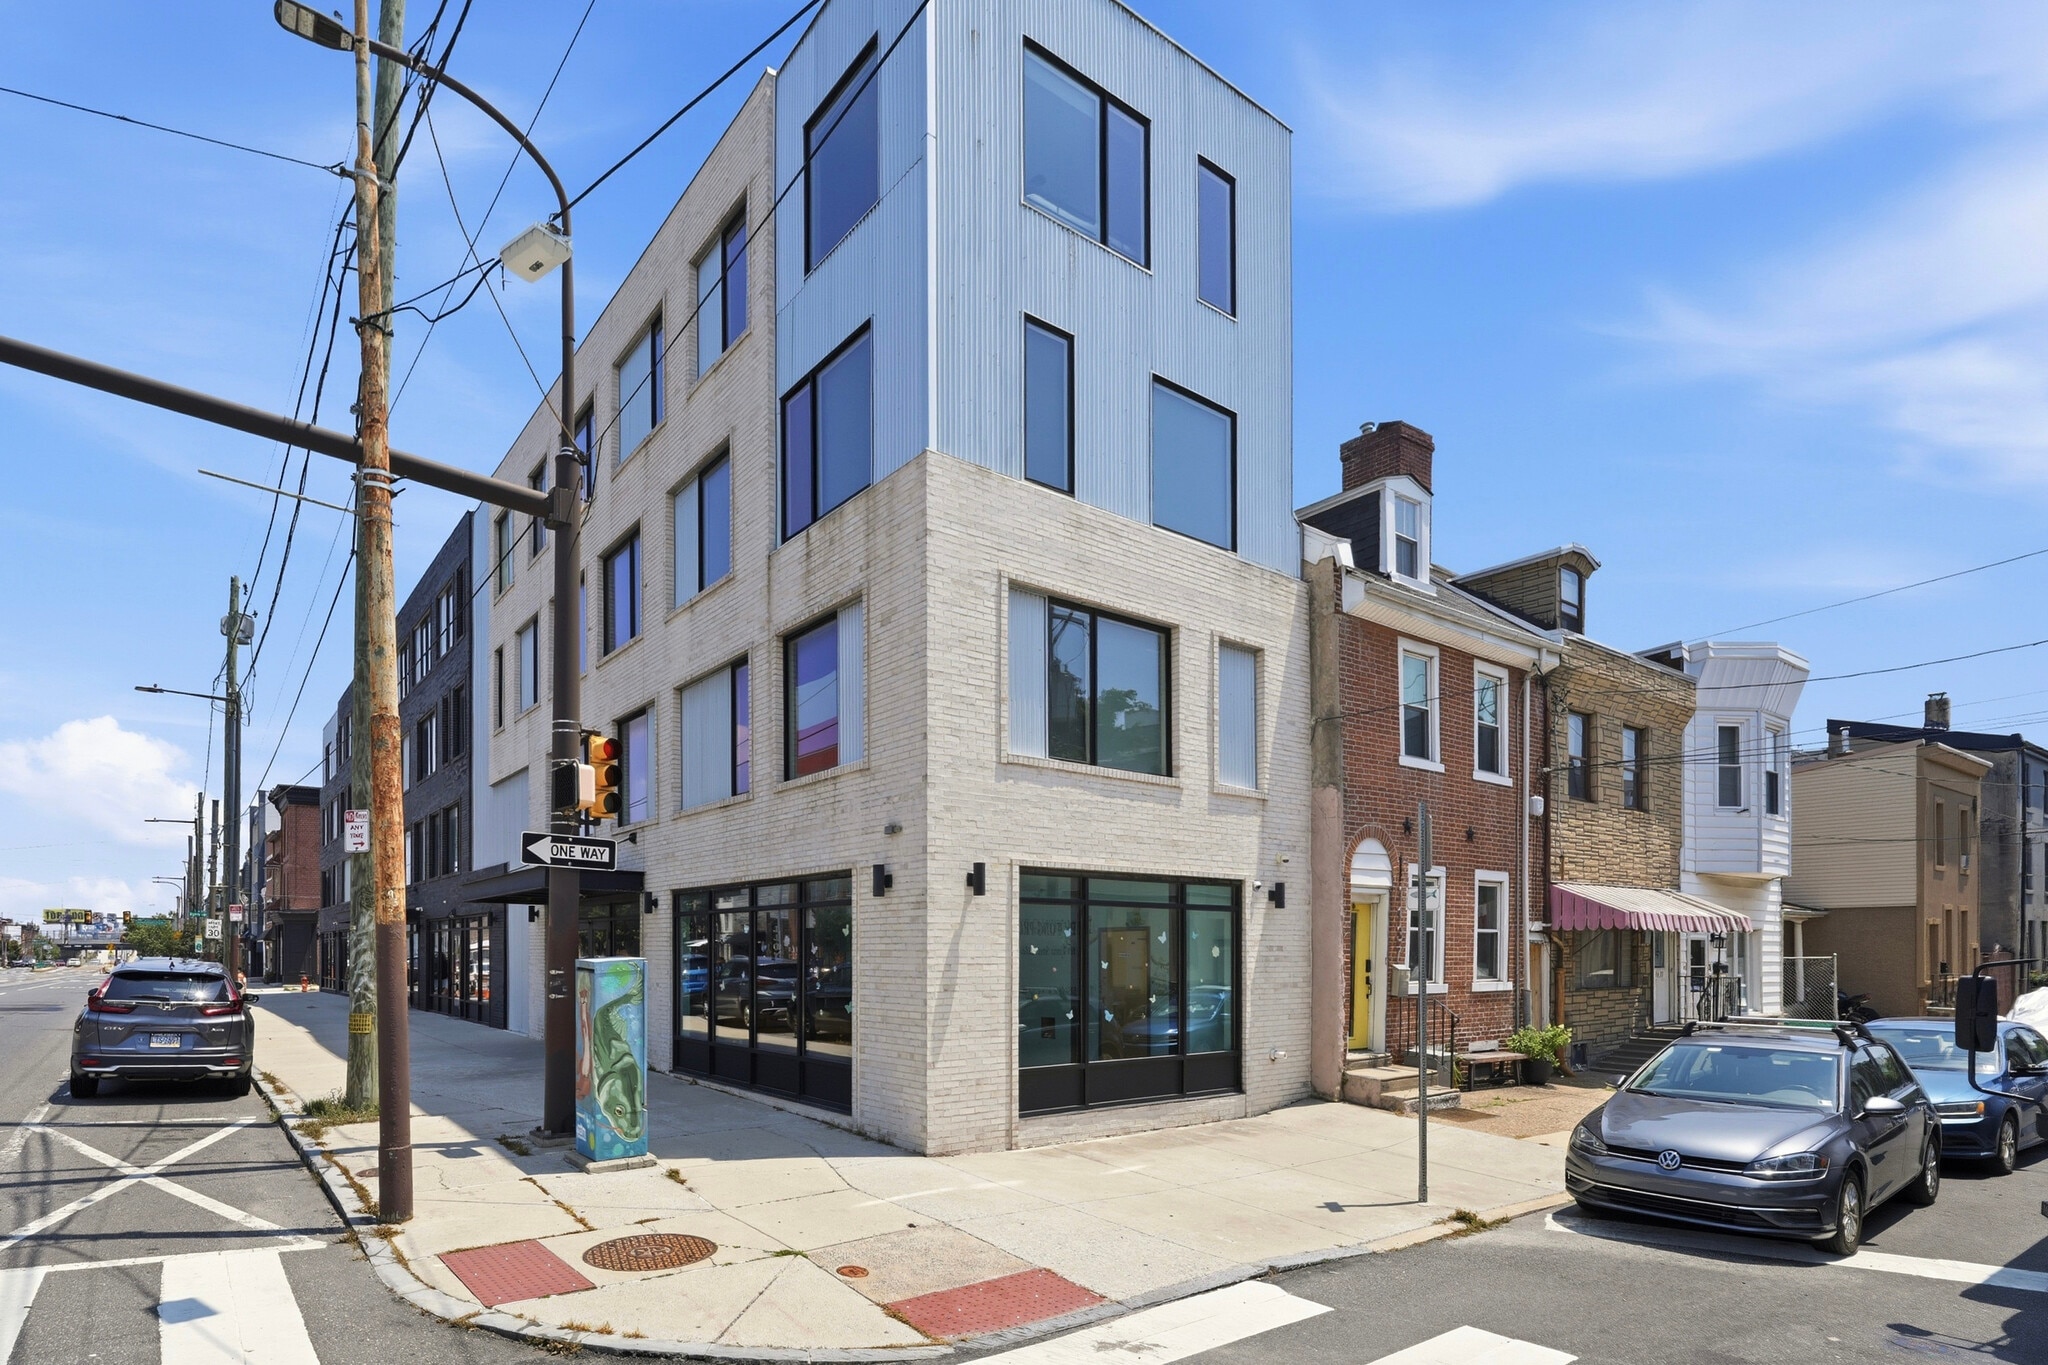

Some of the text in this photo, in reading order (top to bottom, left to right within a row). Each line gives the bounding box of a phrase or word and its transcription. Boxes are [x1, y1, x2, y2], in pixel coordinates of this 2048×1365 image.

[550, 844, 607, 861] ONE WAY
[207, 929, 220, 937] 30
